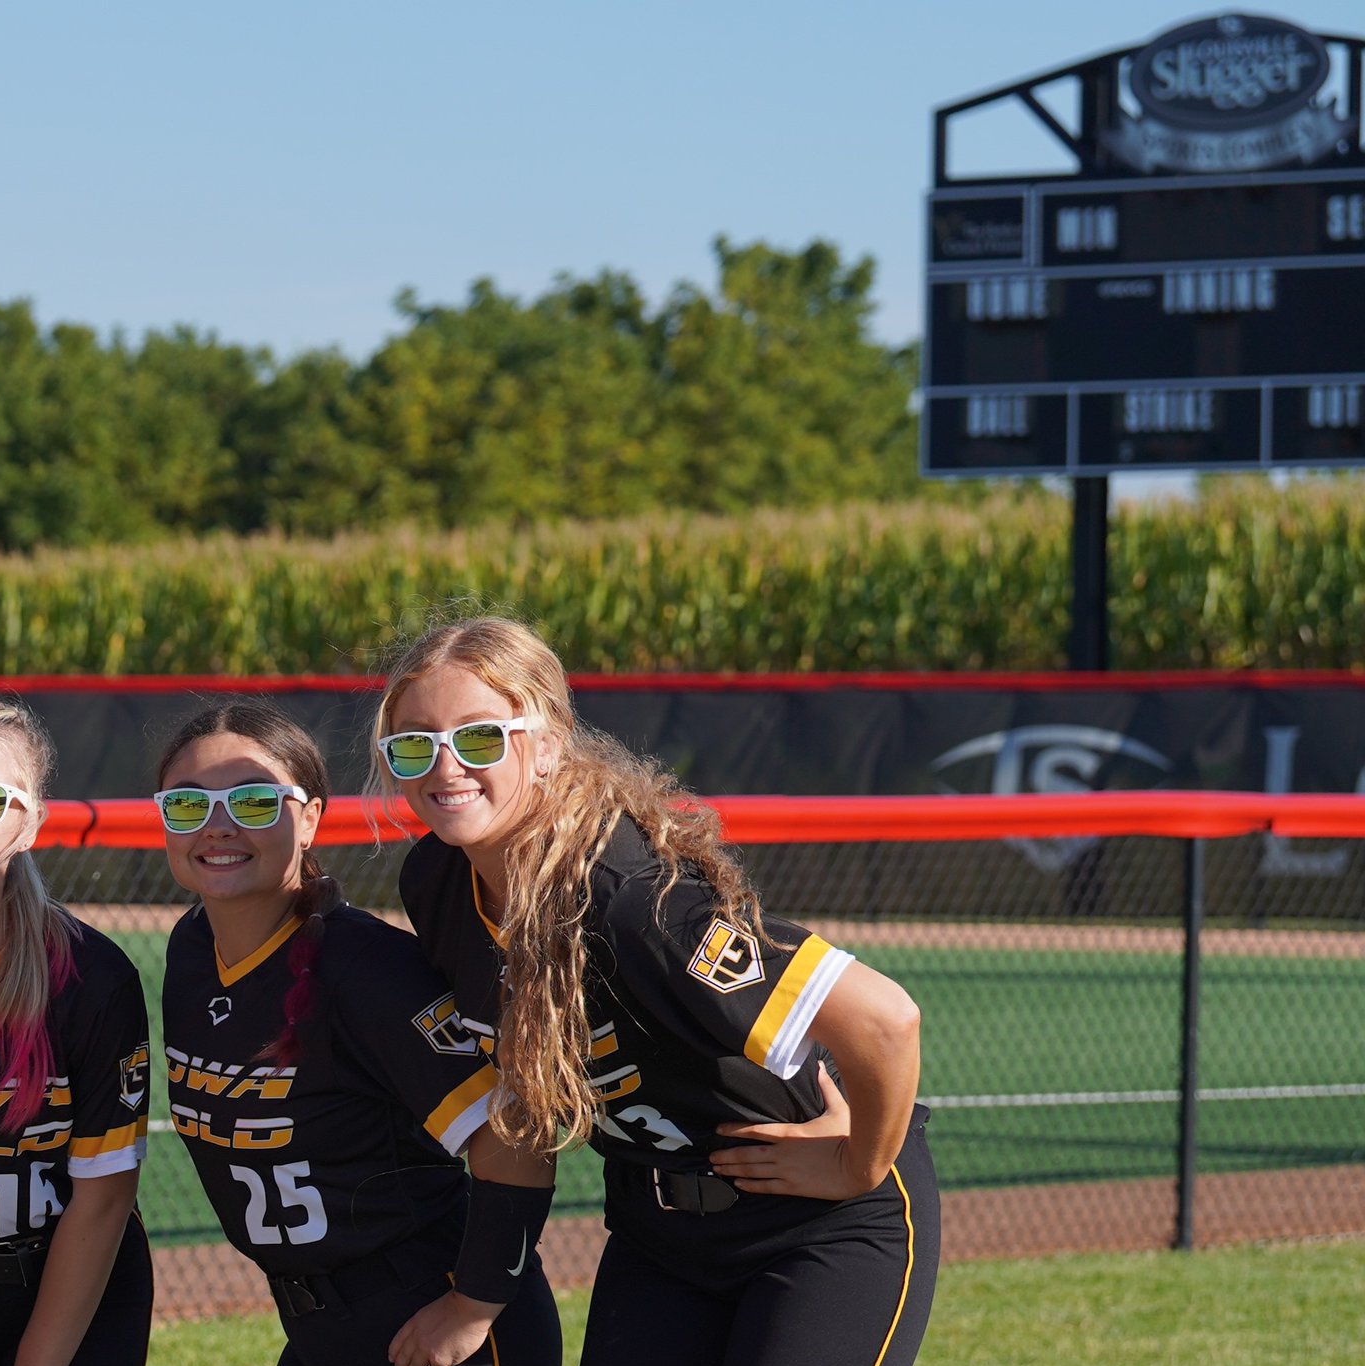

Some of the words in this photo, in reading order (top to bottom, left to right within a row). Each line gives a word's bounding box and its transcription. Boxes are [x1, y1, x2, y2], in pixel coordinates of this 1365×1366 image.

[1150, 49, 1317, 109] Slugger
[165, 1045, 298, 1099] OWA
[171, 1103, 295, 1150] OLD
[229, 1160, 328, 1245] 25
